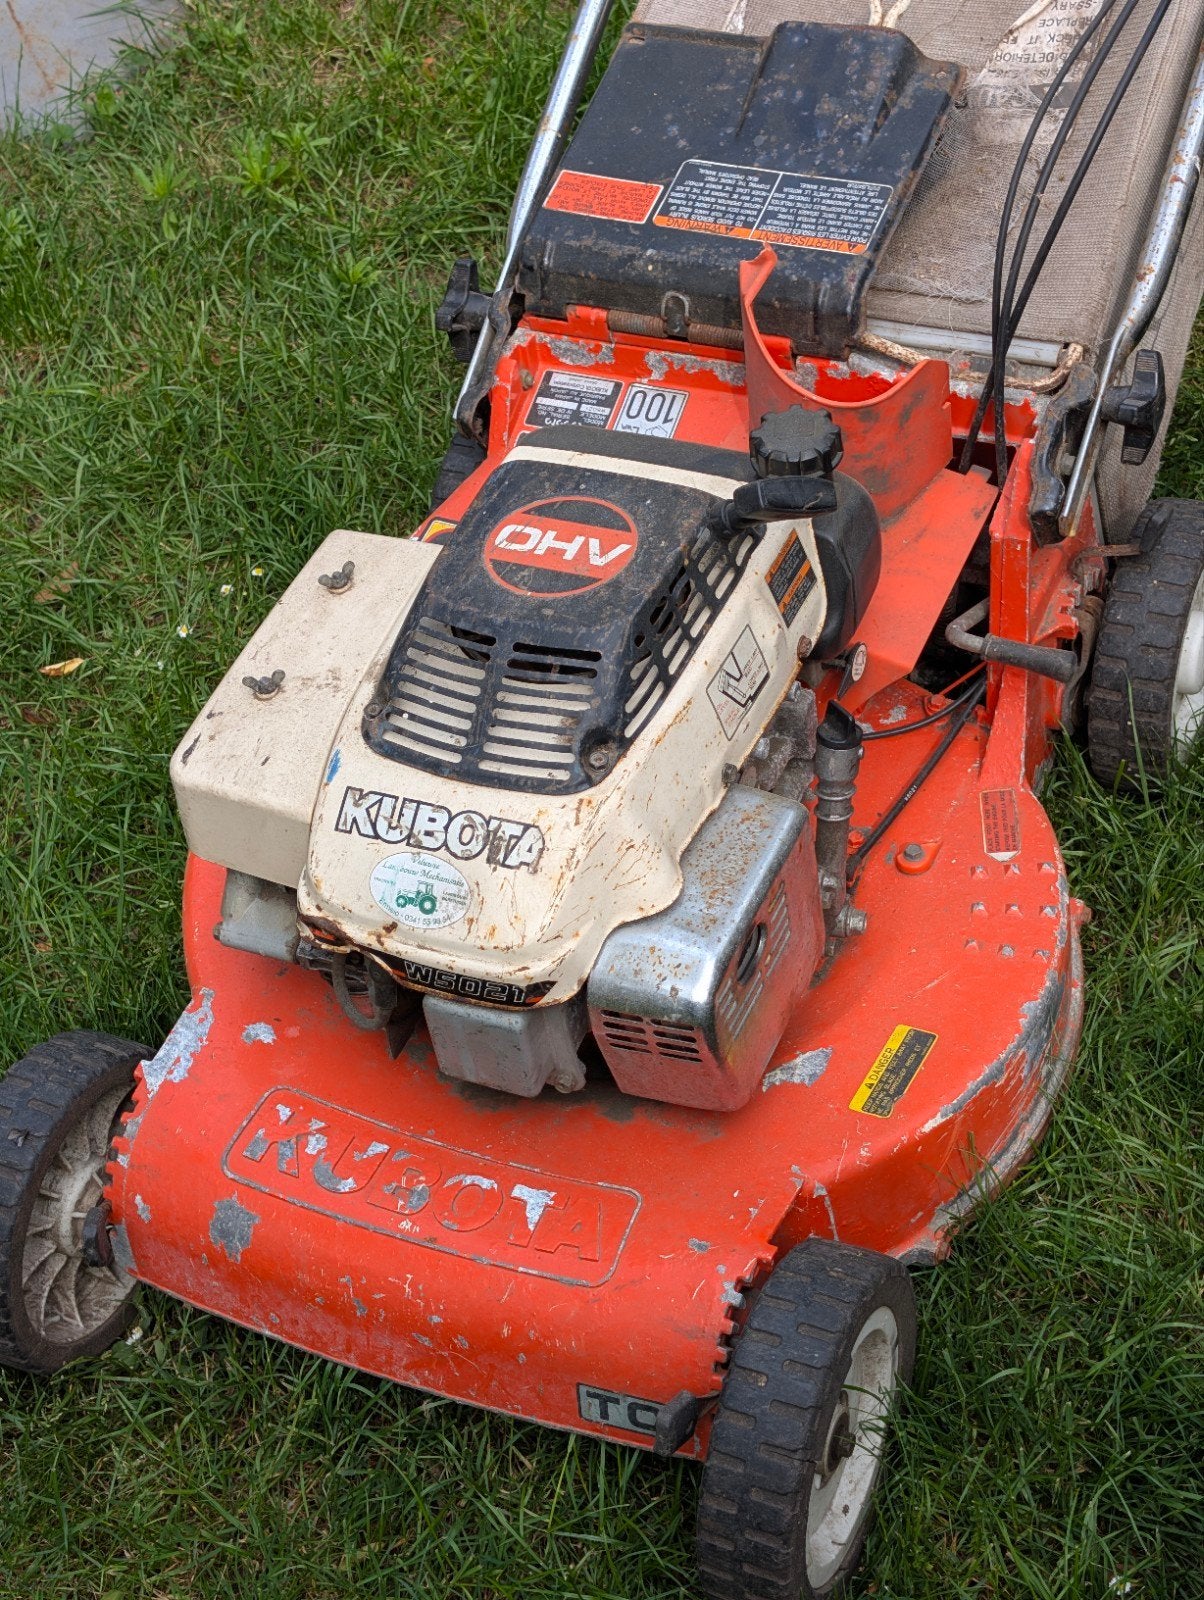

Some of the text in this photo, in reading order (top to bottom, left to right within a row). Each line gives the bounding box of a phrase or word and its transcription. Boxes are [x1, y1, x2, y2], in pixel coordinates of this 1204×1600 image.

[1026, 35, 1038, 44] IT
[665, 217, 720, 232] WARNING
[690, 214, 714, 222] SERIOUS
[758, 223, 791, 233] D'ACCIDENT
[757, 231, 842, 250] AVERTISSEMENT
[792, 227, 816, 236] RISQUES
[626, 390, 676, 424] 100
[496, 524, 632, 566] OHV
[334, 786, 545, 872] KUBOTA
[404, 961, 526, 1003] W5021
[868, 1047, 895, 1079] DANGER
[242, 1103, 604, 1262] KUBOTA
